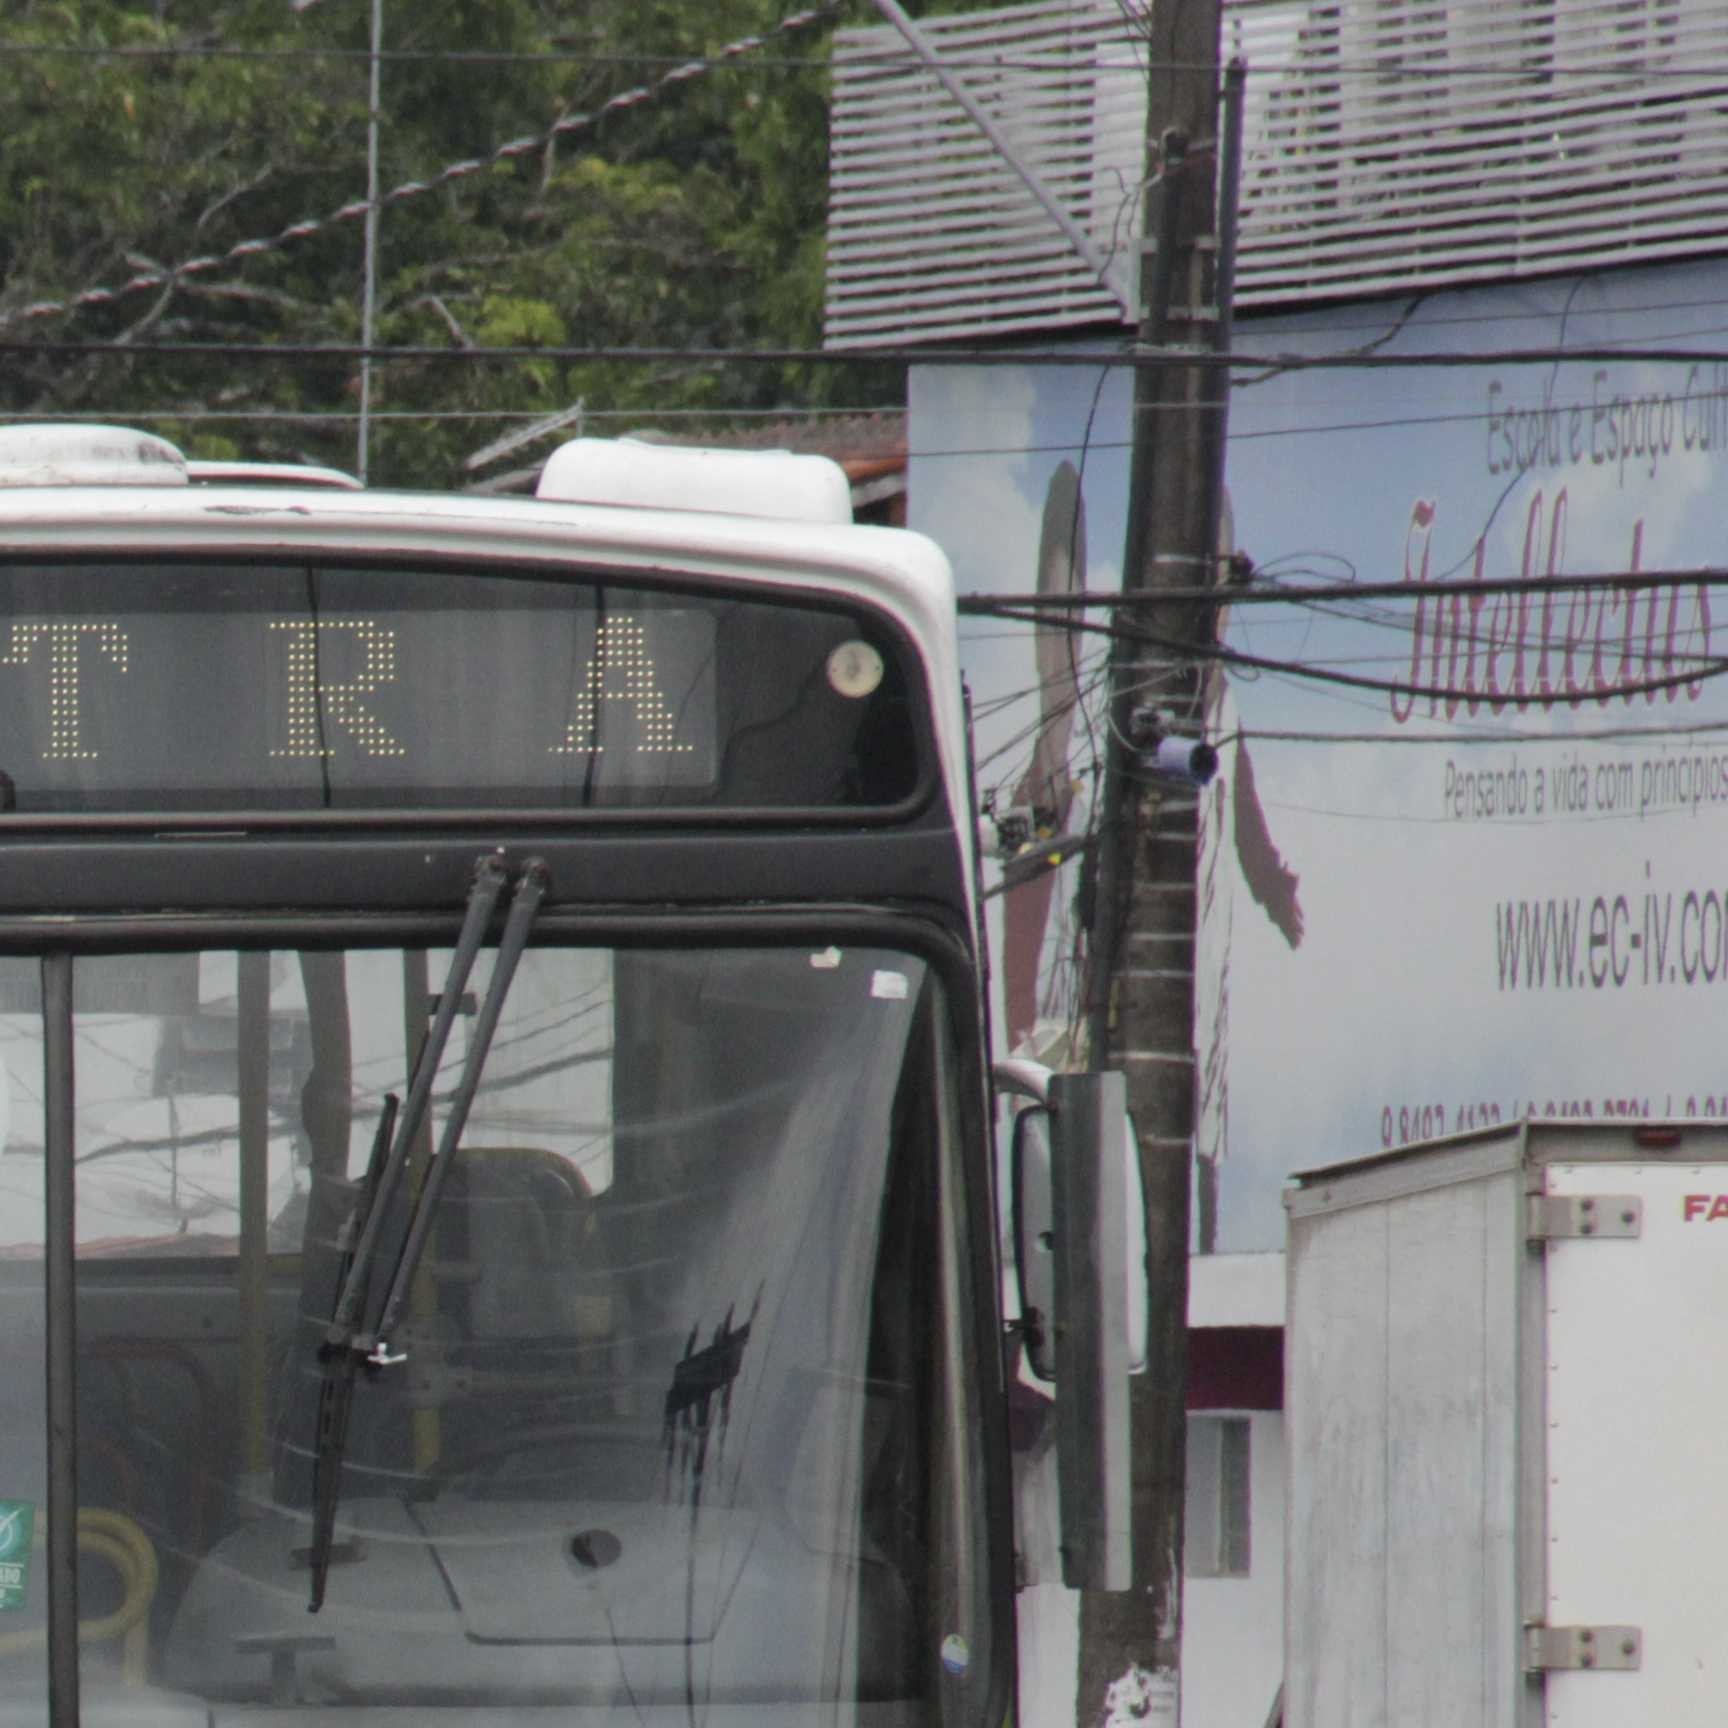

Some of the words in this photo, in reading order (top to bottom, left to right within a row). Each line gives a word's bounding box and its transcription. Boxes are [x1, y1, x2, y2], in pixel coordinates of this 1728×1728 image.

[1445, 756, 1529, 818] Pensando
[1536, 767, 1544, 813] a
[1553, 752, 1590, 812] vida
[1597, 760, 1634, 810] com
